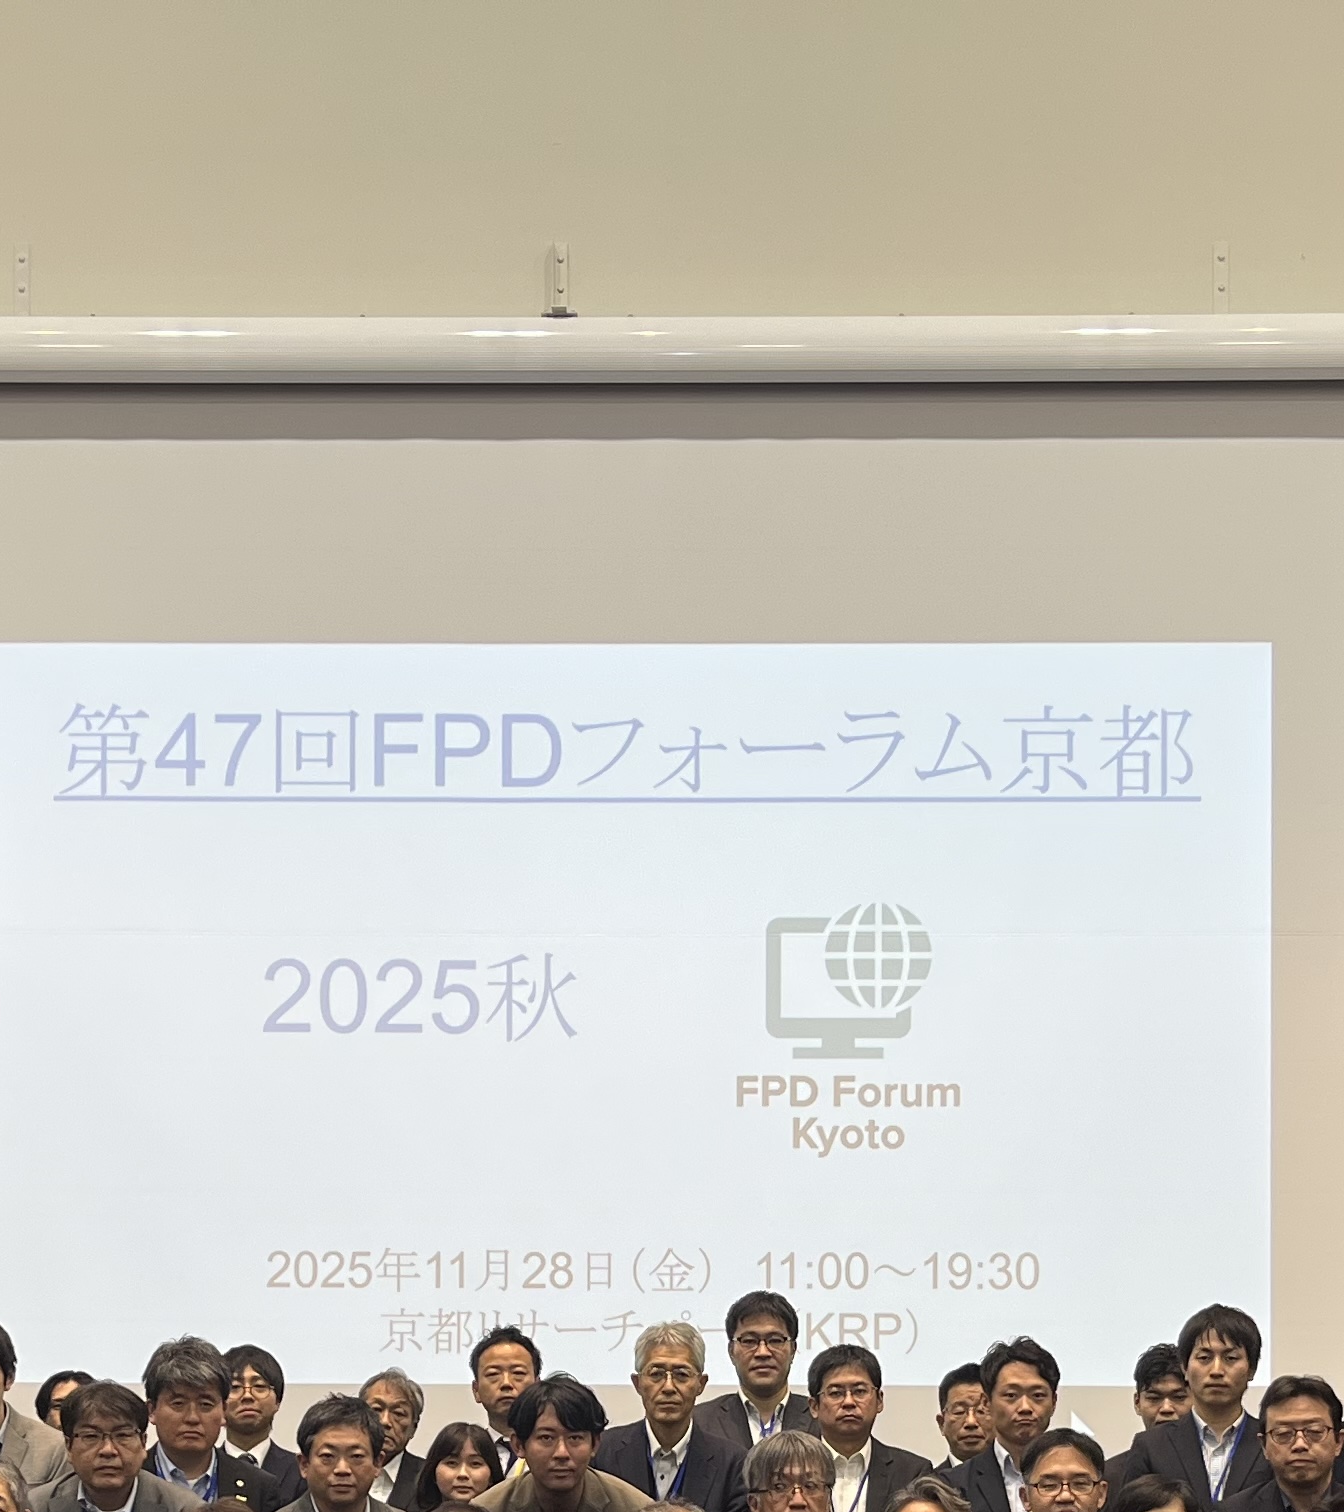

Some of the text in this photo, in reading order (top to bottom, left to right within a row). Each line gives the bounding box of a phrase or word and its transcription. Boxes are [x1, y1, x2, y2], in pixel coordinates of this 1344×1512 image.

[58, 702, 1194, 798] 第47回FPDフォーラム京都
[262, 952, 578, 1043] 2025秋
[736, 1074, 962, 1108] FPD Forum
[792, 1116, 905, 1158] Kyoto
[265, 1246, 712, 1294] 2025年11月28日（金）
